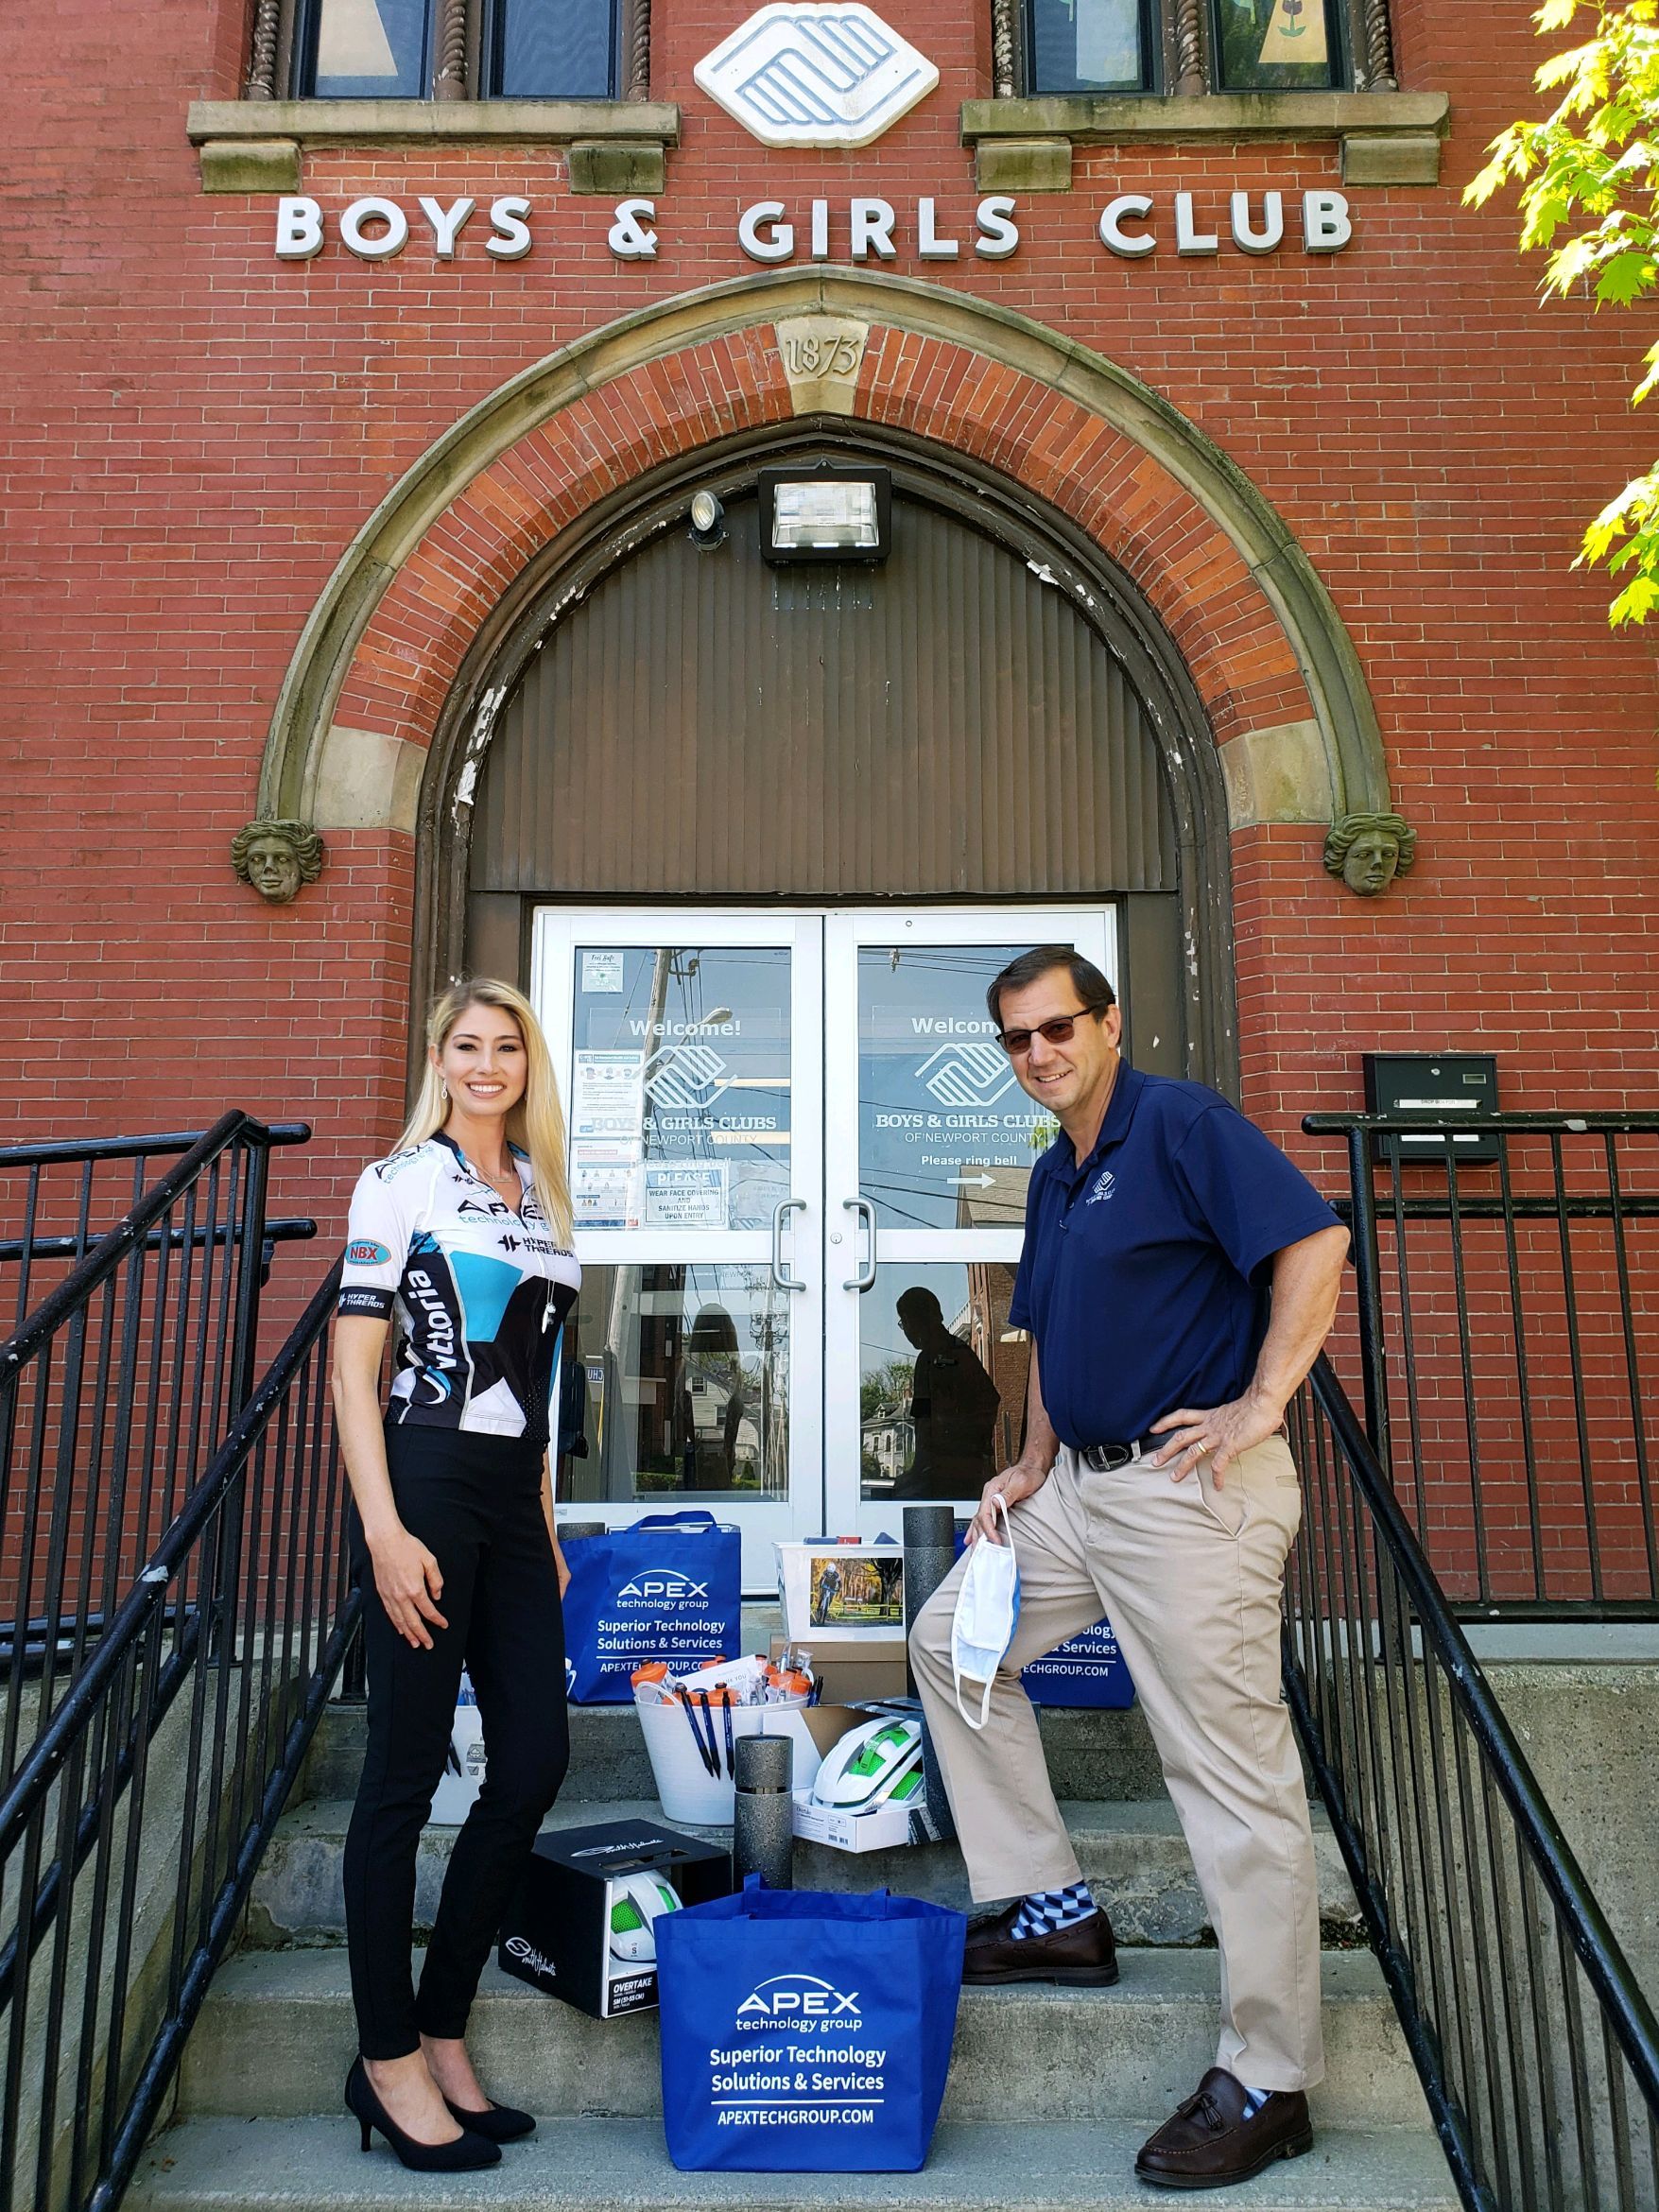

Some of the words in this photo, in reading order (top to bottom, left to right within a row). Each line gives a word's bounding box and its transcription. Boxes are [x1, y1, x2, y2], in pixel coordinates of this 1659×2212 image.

[275, 195, 533, 261] BOYS
[608, 199, 658, 261] &
[739, 196, 1020, 264] GIRLS
[1099, 190, 1355, 257] CLUB
[786, 336, 858, 378] 1873
[630, 1020, 741, 1036] Welcome!
[911, 1017, 1000, 1034] Welcom
[643, 1117, 658, 1130] &
[662, 1117, 715, 1131] GIRLS
[718, 1117, 777, 1130] CLUBS
[875, 1115, 924, 1128] BOYS
[926, 1115, 942, 1128] &
[945, 1115, 999, 1128] GIRLS
[1003, 1115, 1061, 1128] CLUBS
[644, 1135, 704, 1145] NEWPORT
[707, 1135, 757, 1145] COUNTY
[905, 1133, 922, 1143] OF
[925, 1133, 987, 1143] NEWPORT
[991, 1133, 1043, 1143] COUNTY
[921, 1155, 962, 1166] Please
[965, 1155, 991, 1167] ring
[994, 1155, 1017, 1166] bell
[657, 1172, 710, 1186] PLEASE
[457, 1200, 544, 1220] APE
[350, 1246, 378, 1260] NBX
[347, 1293, 376, 1302] HYPER
[347, 1299, 386, 1308] THREADS
[617, 1581, 709, 1598] APEX
[616, 1599, 677, 1610] technology
[678, 1599, 709, 1611] group
[597, 1619, 652, 1634] Superior
[654, 1619, 726, 1634] Technology
[597, 1637, 656, 1650] Solutions
[658, 1637, 668, 1649] &
[671, 1637, 723, 1649] Services
[1063, 1641, 1117, 1654] Services
[1023, 1664, 1109, 1677] ECHGROUP.COM
[613, 1977, 652, 1994] OVERTAKE
[737, 1992, 861, 2014] APEX
[736, 2016, 817, 2032] technology
[821, 2018, 862, 2032] group
[710, 2046, 783, 2067] Superior
[786, 2046, 886, 2067] Technology
[712, 2072, 790, 2092] Solutions
[794, 2073, 807, 2091] &
[812, 2072, 885, 2091] Services
[717, 2109, 873, 2125] APEXTECHGROUP.COM
